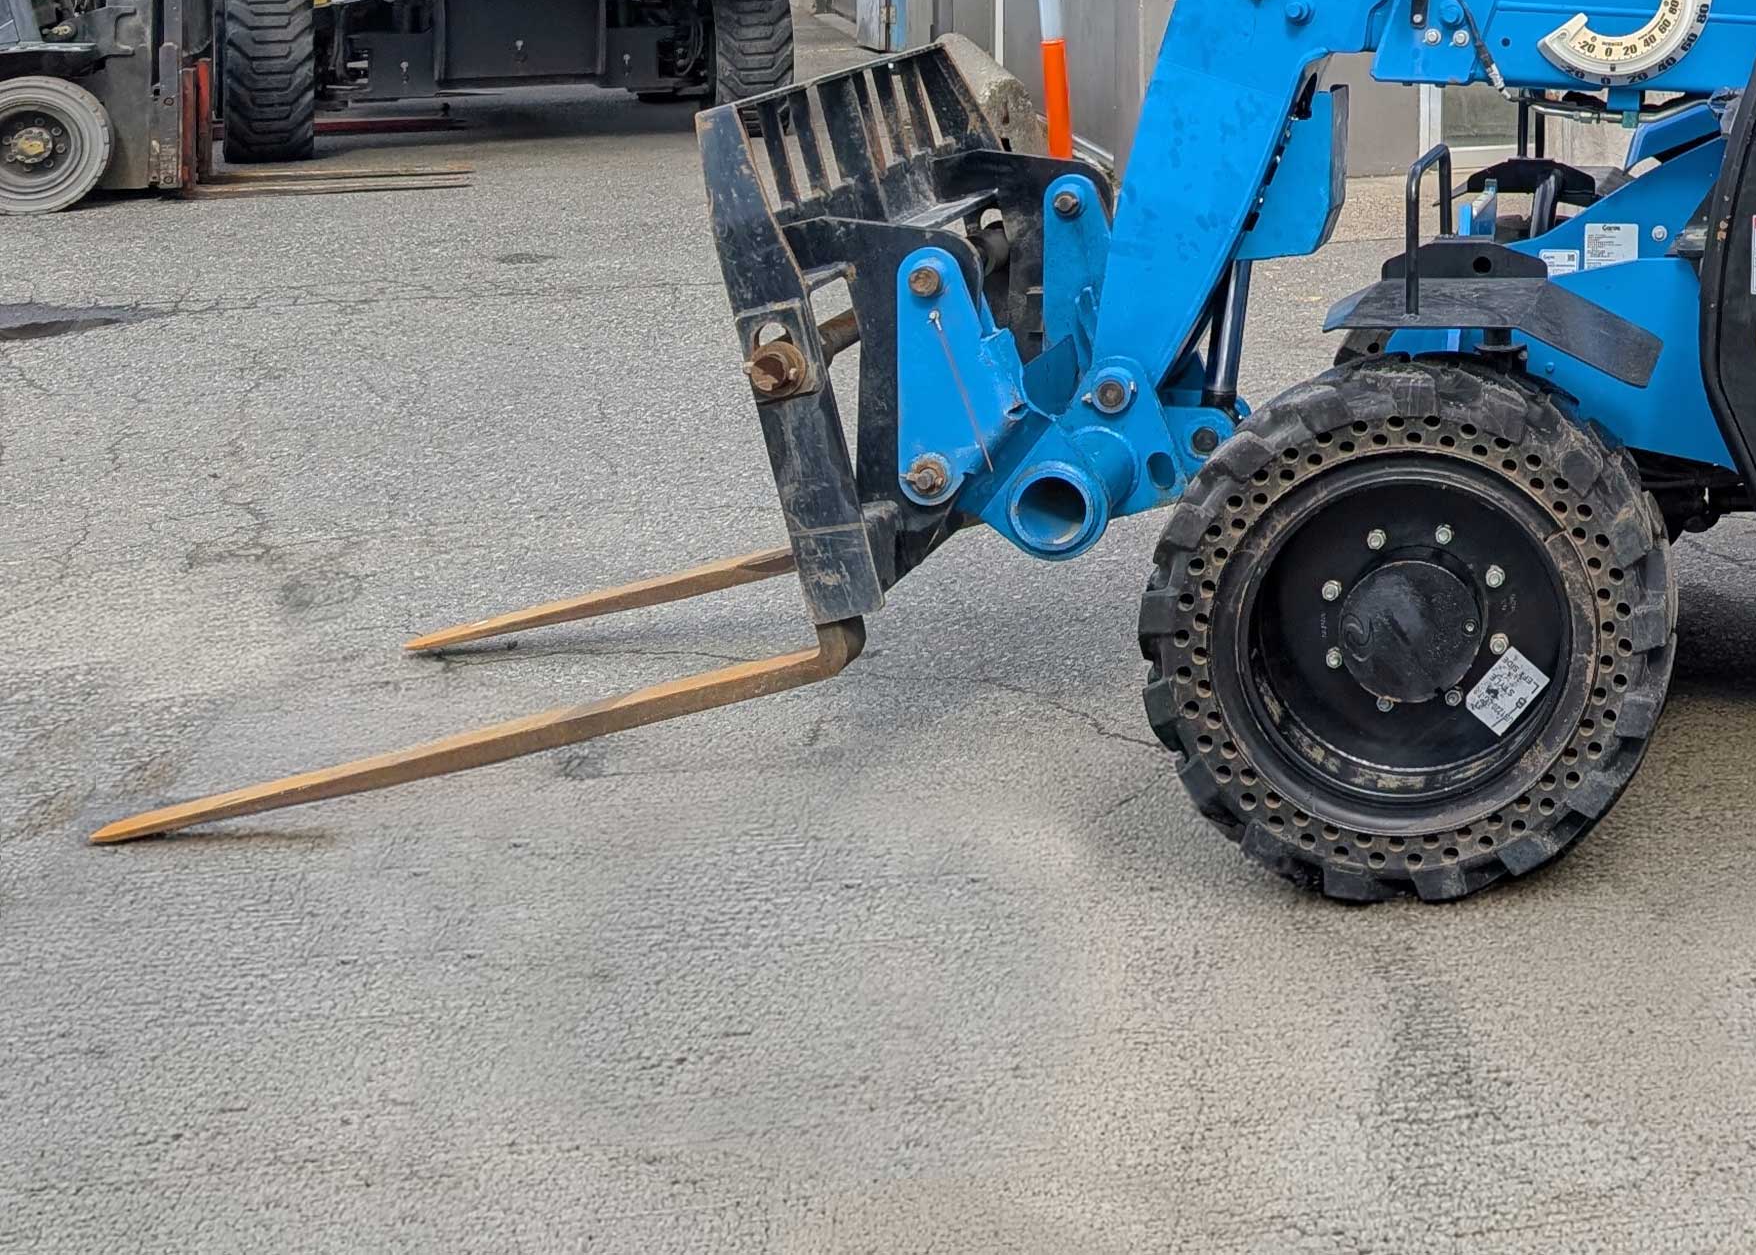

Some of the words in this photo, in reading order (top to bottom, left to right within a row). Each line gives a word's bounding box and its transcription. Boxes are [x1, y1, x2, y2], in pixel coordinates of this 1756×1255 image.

[1658, 18, 1671, 35] 60
[1643, 33, 1657, 48] 40
[1605, 46, 1613, 57] 0
[1622, 43, 1638, 56] 20
[1626, 71, 1649, 84] 20
